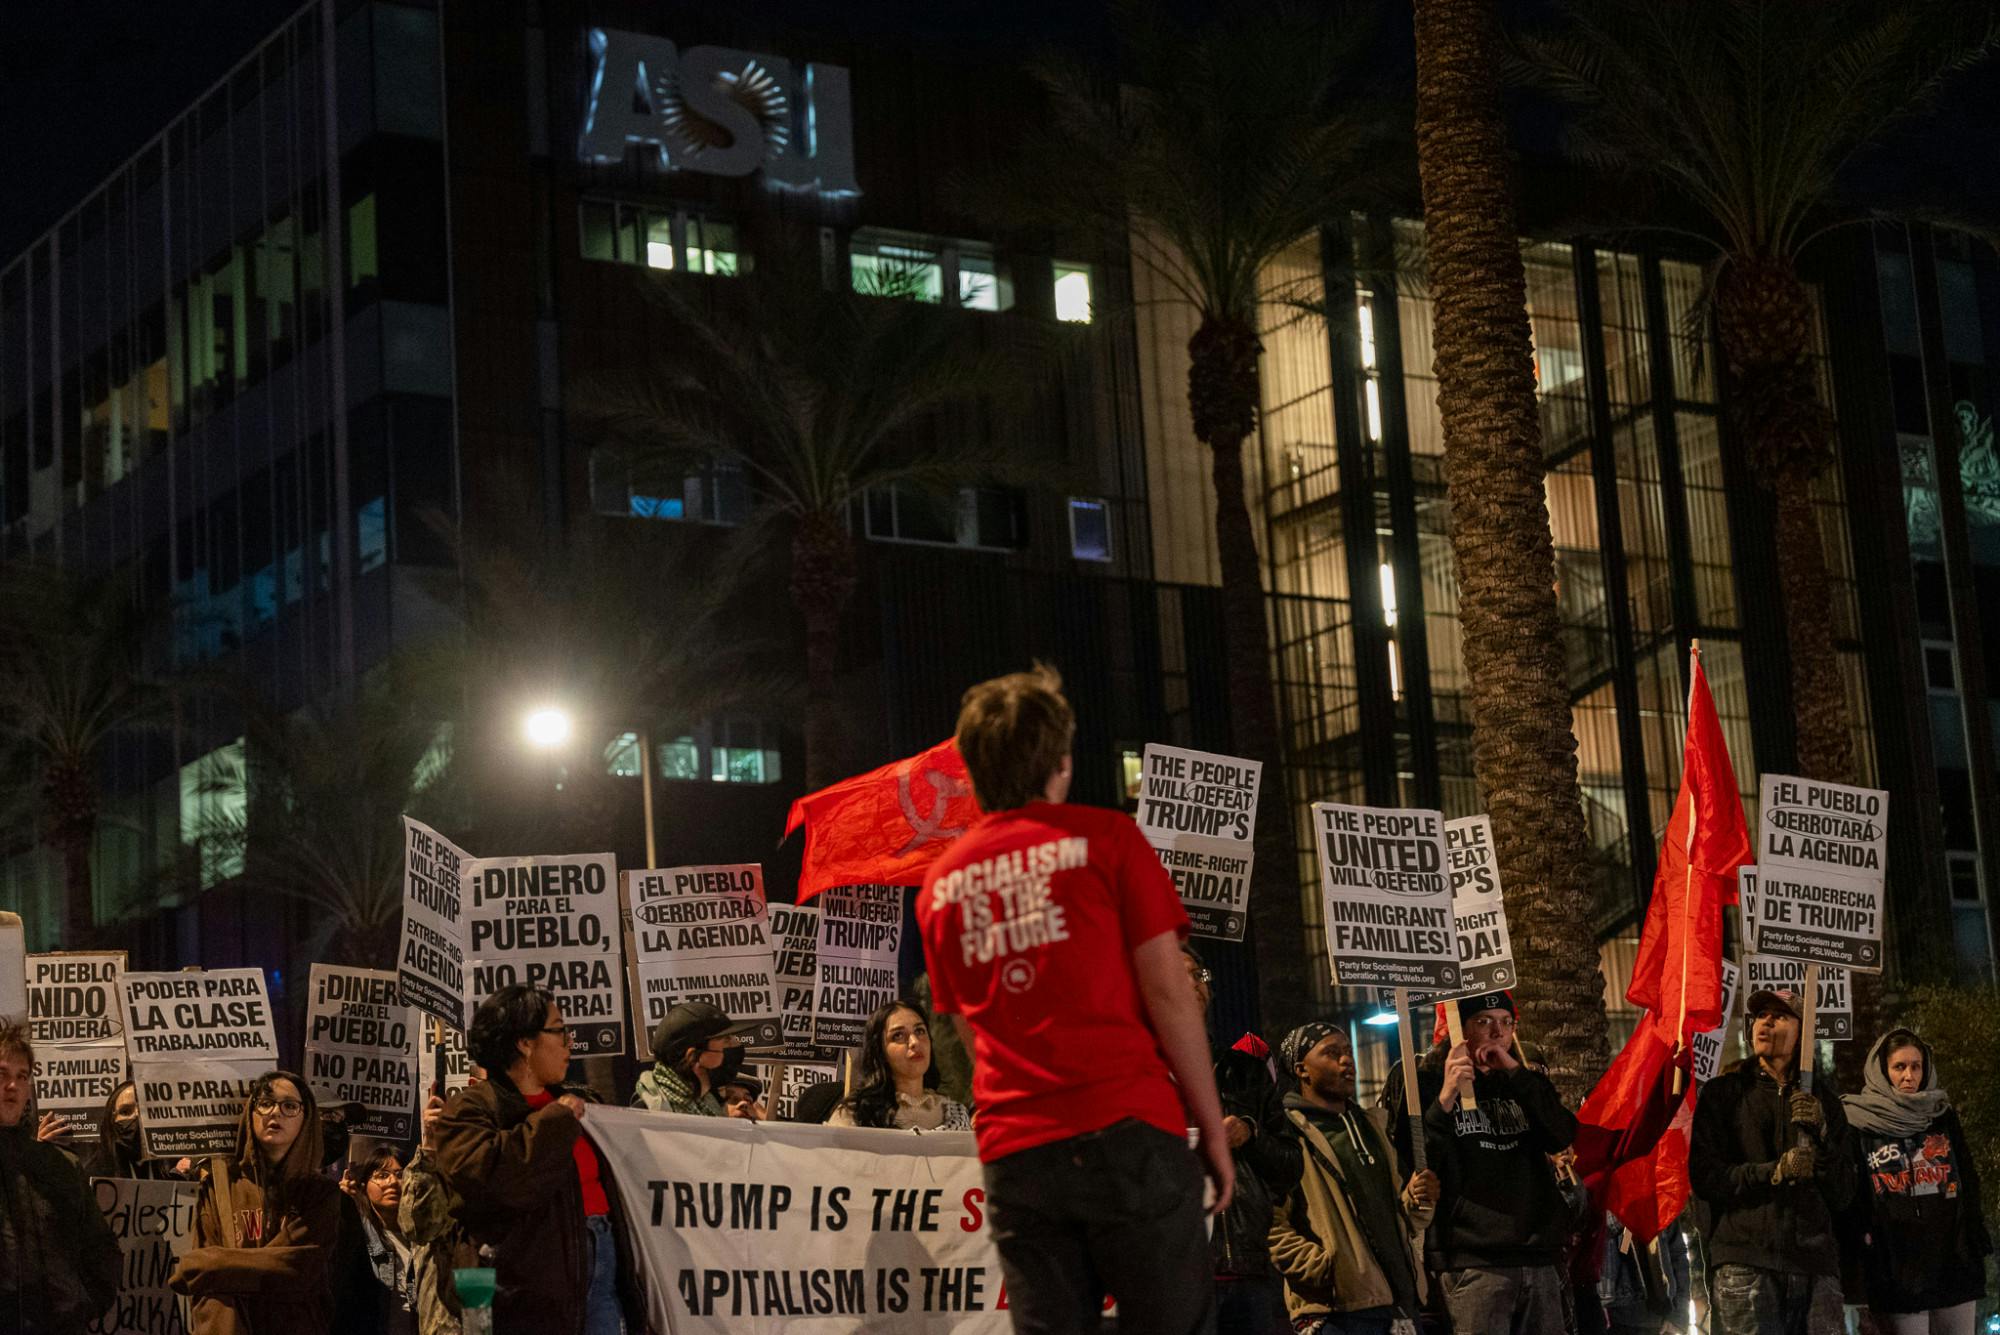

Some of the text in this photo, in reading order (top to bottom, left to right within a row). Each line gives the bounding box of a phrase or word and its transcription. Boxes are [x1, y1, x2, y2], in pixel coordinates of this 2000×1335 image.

[1150, 754, 1255, 790] THE PEOPLE
[1150, 778, 1252, 810] WILL DEFEAT
[1773, 783, 1879, 816] ¡EL PUEBLO
[1146, 801, 1250, 840] TRUMP'S
[1322, 810, 1438, 837] THE PEOPLE
[1775, 810, 1874, 842] DERROTARÁ
[410, 827, 460, 874] THE PEOP
[1446, 824, 1486, 849] PLE
[1156, 848, 1248, 874] TREME-RIGHT
[1326, 833, 1441, 873] UNITED
[1769, 834, 1879, 870] LA AGENDA
[410, 851, 460, 897] WILL DEFE
[474, 863, 606, 906] ¡DINERO
[639, 871, 754, 902] ¡EL PUEBLO
[932, 837, 1088, 911] SOCIALISM
[1171, 869, 1244, 904] ENDA!
[1330, 867, 1443, 892] WILL DEFEND
[409, 871, 460, 923] TRUMP
[506, 898, 574, 916] PARA EL
[857, 884, 900, 902] PEOPLE
[961, 873, 1052, 930] IS THE
[1765, 880, 1876, 910] ULTRADERECHA
[644, 896, 756, 924] DERROTARÁ
[826, 898, 899, 924] WILL DEFEAT
[1333, 902, 1446, 928] IMMIGRANT
[1764, 898, 1792, 922] DE
[1798, 902, 1874, 934] TRUMP!
[408, 918, 462, 966] EXTREME-RIG
[471, 914, 610, 952] PUEBLO,
[642, 924, 766, 952] LA AGENDA
[824, 919, 898, 952] TRUMP'S
[960, 906, 1070, 968] FUTURE
[1336, 926, 1452, 955] FAMILIES!
[1763, 931, 1844, 948] Party for Socialism and
[1762, 942, 1800, 952] Liberation
[1810, 947, 1852, 961] PSLWeb.org
[37, 963, 116, 984] PUEBLO
[404, 938, 464, 995] AGENDA
[474, 960, 612, 995] NO PARA
[822, 964, 895, 988] BILLIONAIRE
[1340, 962, 1424, 973] Party for Socialism and
[1340, 972, 1378, 981] Liberation
[1388, 974, 1435, 984] PSLWeb.org
[1462, 973, 1474, 982] nd
[127, 978, 260, 1004] ¡PODER PARA
[318, 974, 407, 1007] ¡DINER
[646, 973, 770, 993] MULTIMILLONARIA
[27, 986, 105, 1018] NIDO
[341, 1003, 390, 1020] PARA EL
[557, 994, 612, 1017] RRA!
[782, 988, 812, 1010] PA
[1486, 996, 1498, 1008] P
[130, 1002, 266, 1031] LA CLASE
[134, 1032, 270, 1052] TRABAJADORA,
[312, 1016, 411, 1054] PUEBLO,
[48, 1060, 120, 1076] FAMILIAS
[313, 1054, 410, 1086] NO PARA
[144, 1082, 173, 1101] NO
[178, 1081, 233, 1100] PARA
[337, 1084, 410, 1108] GUERRA!
[147, 1104, 244, 1120] MULTIMILLONA
[152, 1132, 174, 1142] Party
[176, 1132, 188, 1140] for
[190, 1130, 232, 1138] Socialism
[154, 1142, 196, 1150] Liberation
[1867, 1144, 1901, 1170] #35
[94, 1179, 194, 1238] Palesti
[648, 1180, 984, 1232] TRUMP IS THE S
[678, 1268, 864, 1316] APITALISM
[876, 1267, 909, 1312] IS
[920, 1267, 985, 1312] THE
